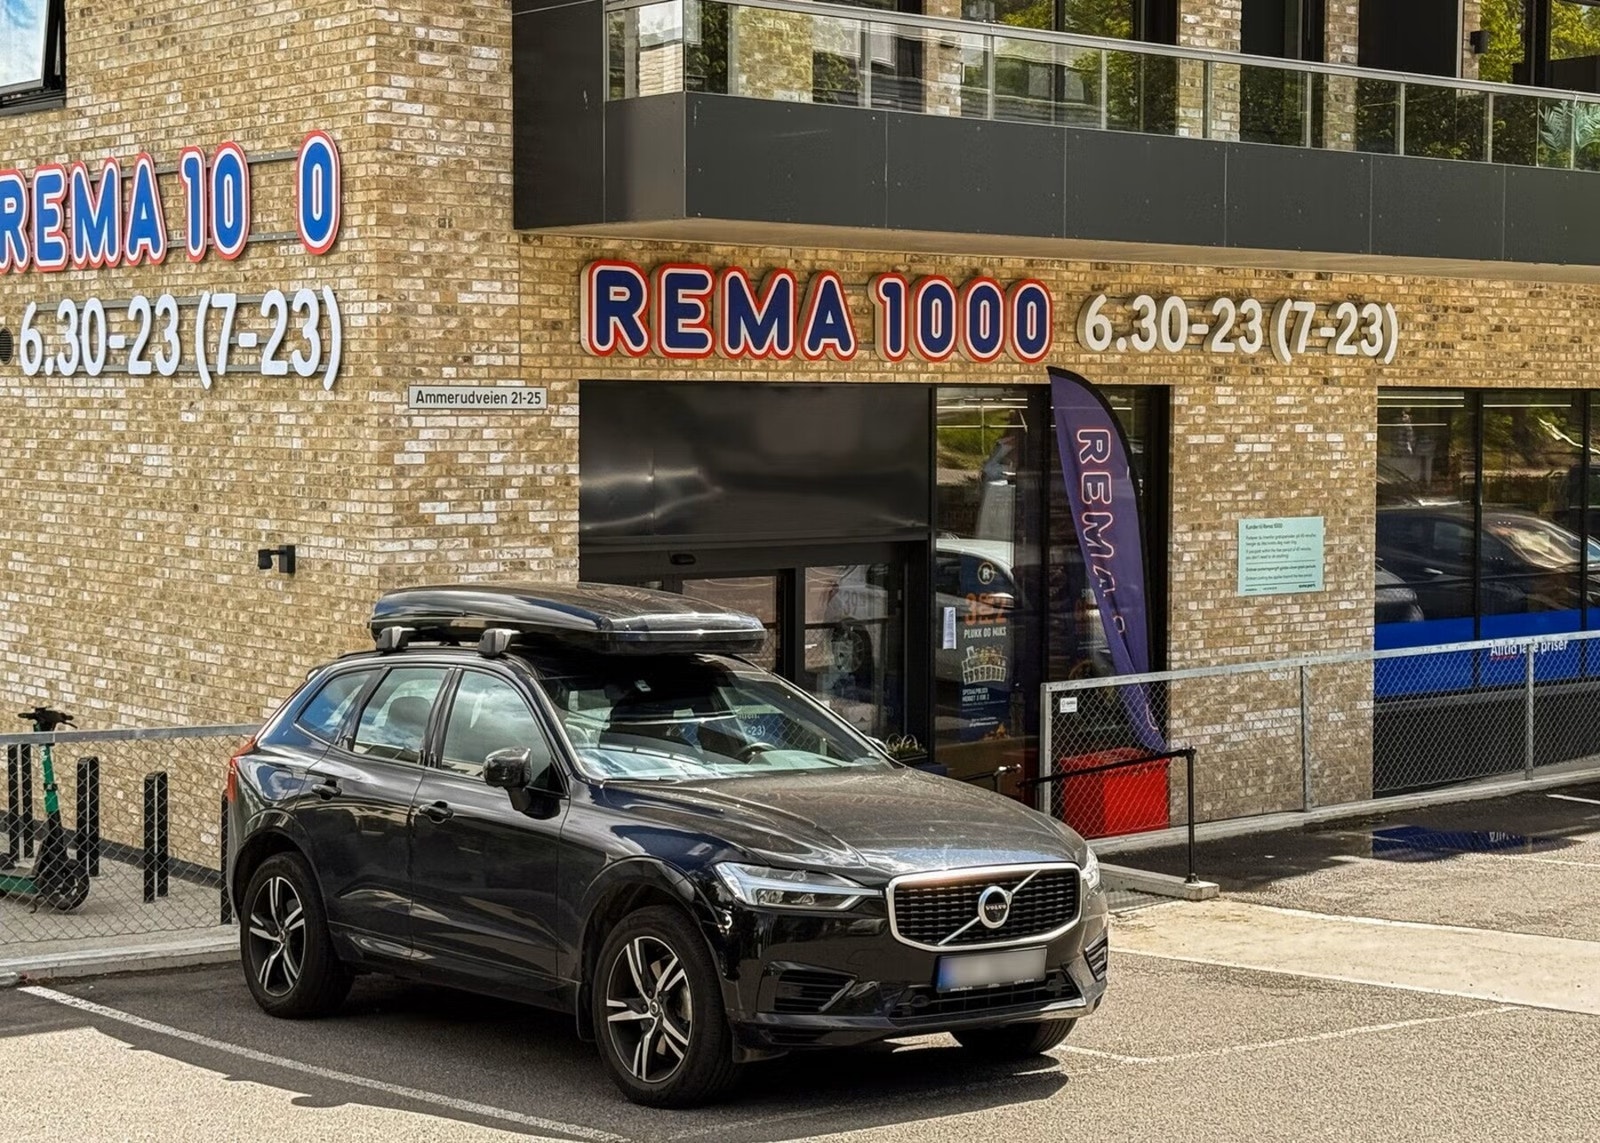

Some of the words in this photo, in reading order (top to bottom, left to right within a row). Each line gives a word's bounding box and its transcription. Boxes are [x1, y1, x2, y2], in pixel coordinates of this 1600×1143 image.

[0, 151, 168, 273] REMA
[19, 294, 181, 377] 6.30-23
[195, 285, 342, 391] (7-23)
[582, 258, 858, 361] REMA
[870, 272, 1053, 363] 1000
[1081, 294, 1264, 354] 6.30-23
[1273, 298, 1399, 365] (7-23)
[416, 390, 508, 405] Ammerudveien
[511, 391, 542, 405] 21-25
[963, 628, 982, 639] PLUKK
[1541, 640, 1568, 654] priser
